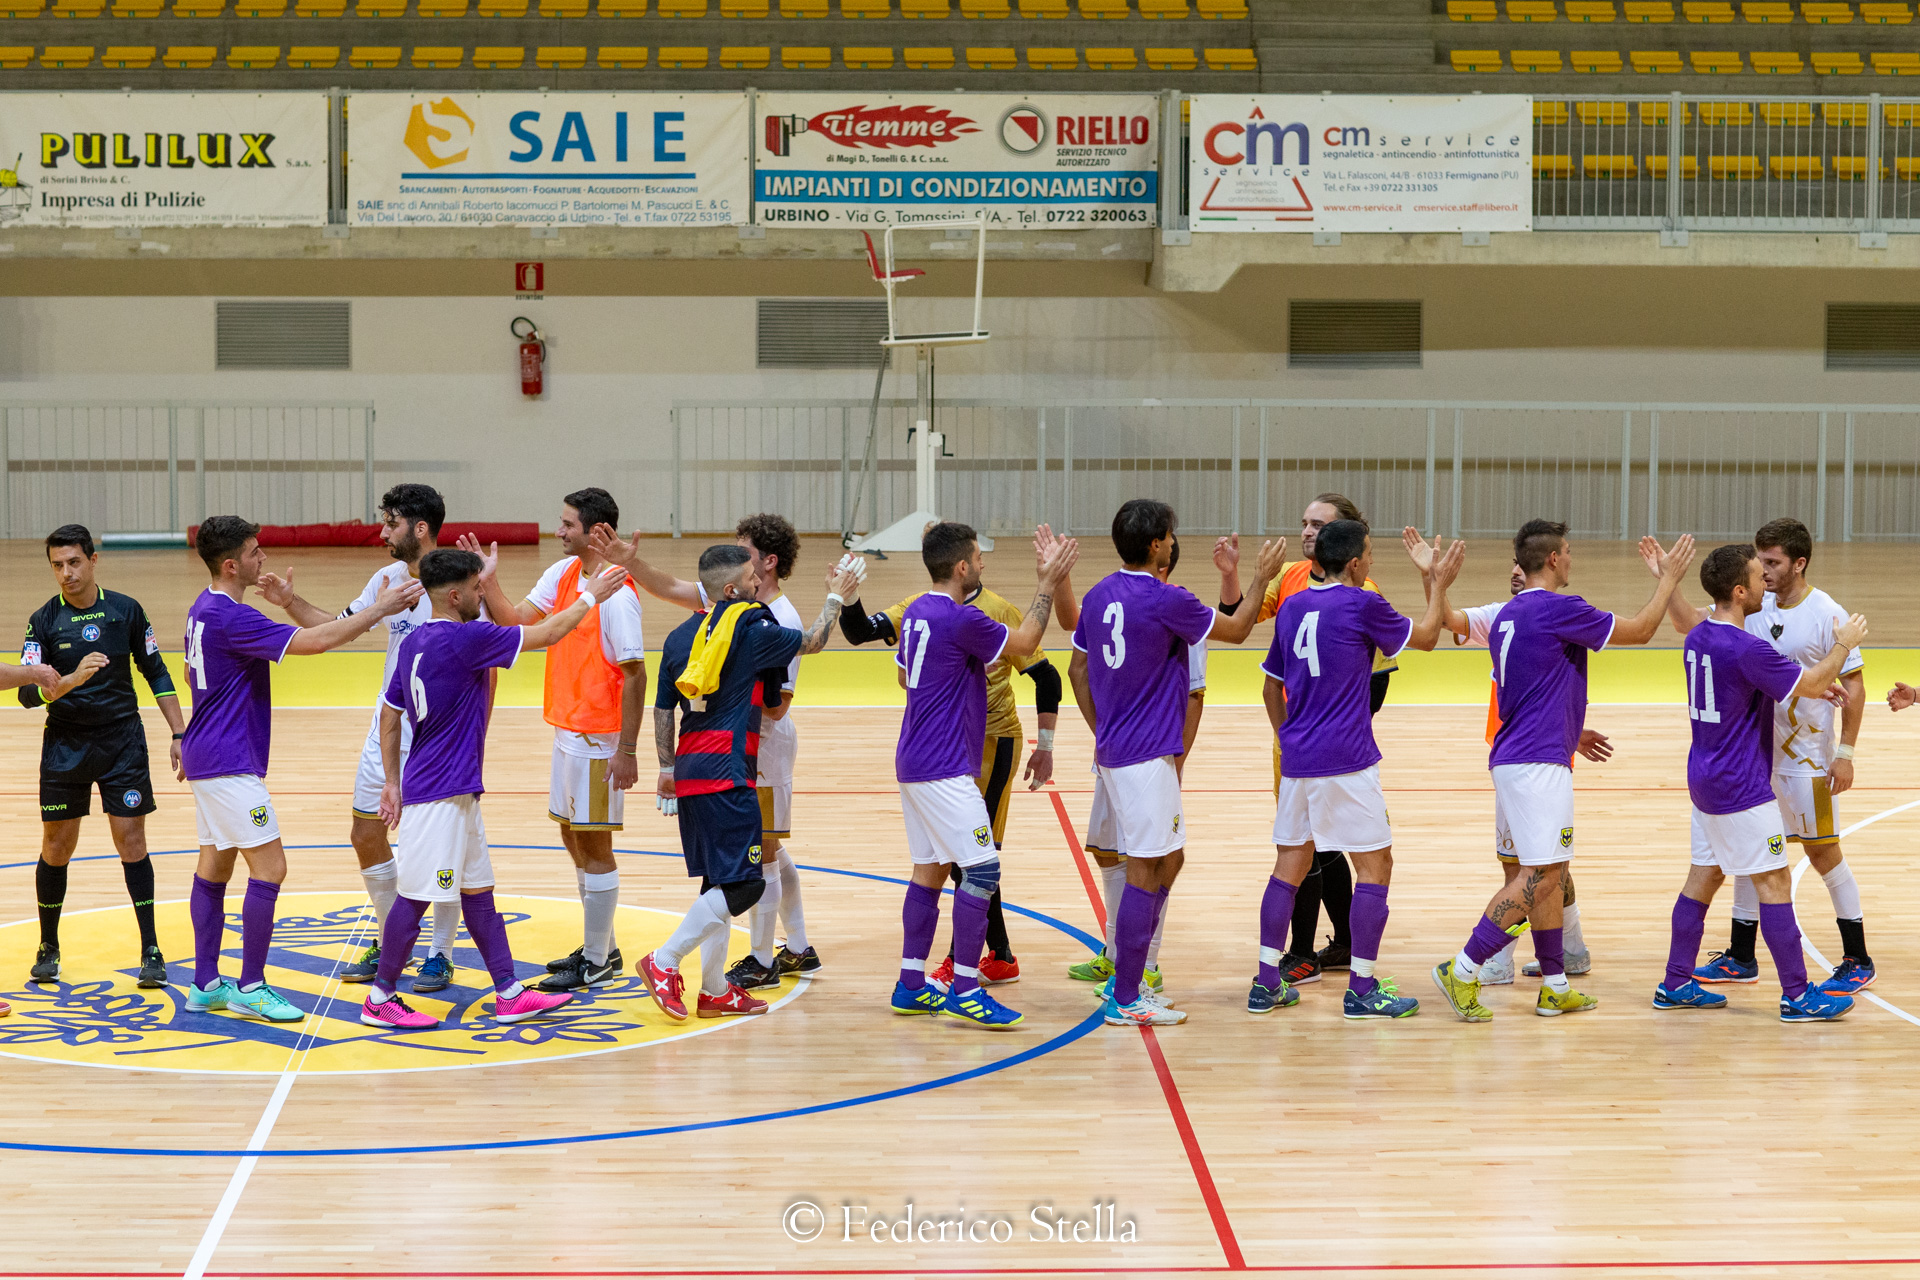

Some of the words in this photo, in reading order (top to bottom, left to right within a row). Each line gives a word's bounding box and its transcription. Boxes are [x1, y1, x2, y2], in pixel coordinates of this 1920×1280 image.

[822, 113, 947, 137] Tiemme
[1056, 115, 1149, 145] RIELLO
[508, 110, 687, 163] SAIE
[1323, 126, 1370, 147] cm
[1379, 133, 1520, 147] service
[40, 132, 276, 168] PULILUX
[286, 158, 312, 168] S.a.s.
[1056, 148, 1092, 157] SERVIZIO
[1094, 148, 1127, 156] TECNICO
[1322, 149, 1374, 160] segnaletica
[1381, 149, 1437, 159] antincendio
[826, 154, 834, 163] di
[836, 155, 857, 165] Magi
[872, 155, 898, 163] Tonelli
[900, 155, 909, 163] G.
[911, 155, 917, 163] &
[919, 155, 927, 163] C.
[1056, 158, 1110, 167] AUTORIZZATO
[1203, 165, 1310, 177] service
[1323, 171, 1337, 180] Via
[1338, 171, 1346, 180] L.
[1347, 170, 1389, 181] Falasconi,
[1416, 171, 1443, 180] 61033
[1445, 171, 1499, 182] Fermignano
[1501, 170, 1519, 180] (PU)
[40, 175, 49, 184] di
[51, 175, 78, 184] Sorini
[80, 175, 107, 184] Brivio
[109, 176, 118, 184] &
[399, 185, 457, 194] SBANCAMENTI
[462, 185, 528, 194] AUTOTRASPORTI
[533, 185, 582, 194] FOGNATURE
[587, 185, 640, 194] ACQUEDOTTI
[645, 185, 698, 194] ESCAVAZIONI
[764, 176, 870, 198] IMPIANTI
[879, 177, 903, 198] DI
[910, 177, 1147, 198] CONDIZIONAMENTO
[1323, 182, 1338, 192] Tel.
[1339, 184, 1345, 192] e
[1346, 183, 1361, 192] Fax
[1363, 183, 1380, 192] +39
[1381, 183, 1403, 192] 0722
[1405, 183, 1438, 193] 331305
[41, 191, 115, 211] Impresa
[121, 191, 138, 208] di
[145, 191, 206, 207] Pulizie
[357, 200, 384, 210] SAIE
[387, 202, 405, 210] snc
[408, 200, 418, 210] di
[419, 200, 460, 210] Annibali
[463, 200, 503, 211] Roberto
[506, 200, 558, 211] Iacomucci
[561, 201, 570, 211] P.
[573, 201, 628, 211] Bartolomei
[631, 201, 644, 211] M.
[647, 200, 693, 210] Pascucci
[695, 200, 706, 210] E.
[709, 200, 717, 210] &
[720, 200, 731, 210] C.
[1323, 203, 1402, 212] www.cm-service.it
[1413, 203, 1518, 213] cmservice.staff@libero.it
[357, 212, 374, 222] Via
[377, 212, 395, 222] Del
[495, 212, 556, 222] Canavaccio
[558, 212, 568, 222] di
[570, 212, 604, 223] Urbino
[614, 212, 632, 223] Tel.
[634, 214, 641, 223] e
[671, 212, 696, 222] 0722
[699, 212, 732, 222] 53195
[764, 209, 830, 222] URBINO
[845, 210, 869, 223] Via
[874, 210, 890, 223] G.
[1017, 210, 1041, 223] Tel.
[1046, 210, 1085, 222] 0722
[1090, 210, 1147, 222] 320063
[71, 611, 106, 622] GIVOVA
[1101, 601, 1126, 670] 3
[1292, 610, 1321, 677] 4
[902, 618, 931, 689] 17
[1497, 620, 1516, 688] 7
[410, 652, 428, 722] 6
[1686, 649, 1721, 724] 11
[40, 803, 67, 812] IVOVA
